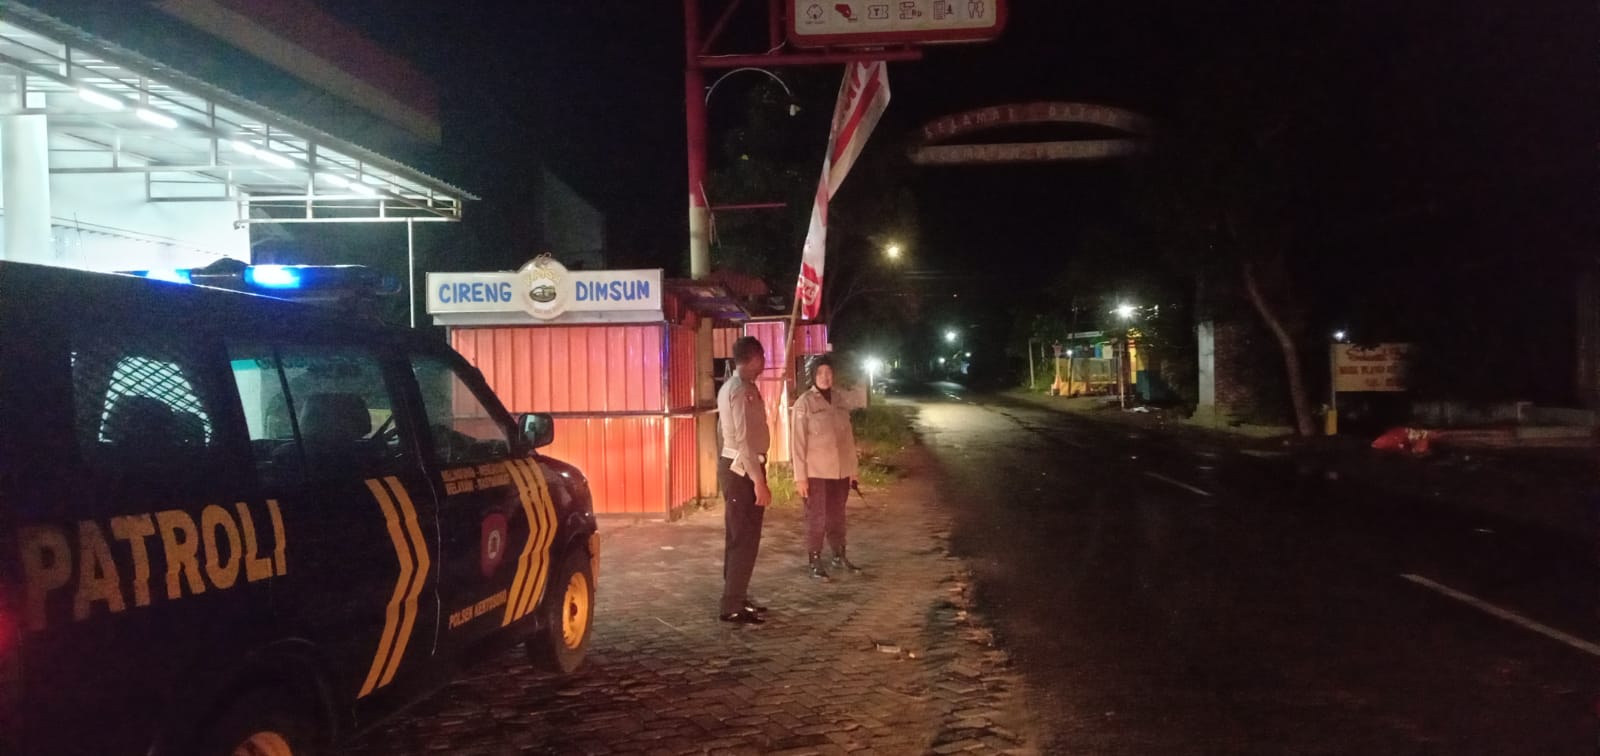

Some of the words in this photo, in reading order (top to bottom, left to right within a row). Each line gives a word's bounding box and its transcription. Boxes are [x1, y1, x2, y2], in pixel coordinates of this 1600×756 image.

[438, 281, 513, 305] CIRENG
[575, 280, 651, 302] DIMSUM
[18, 498, 288, 631] PATROLI
